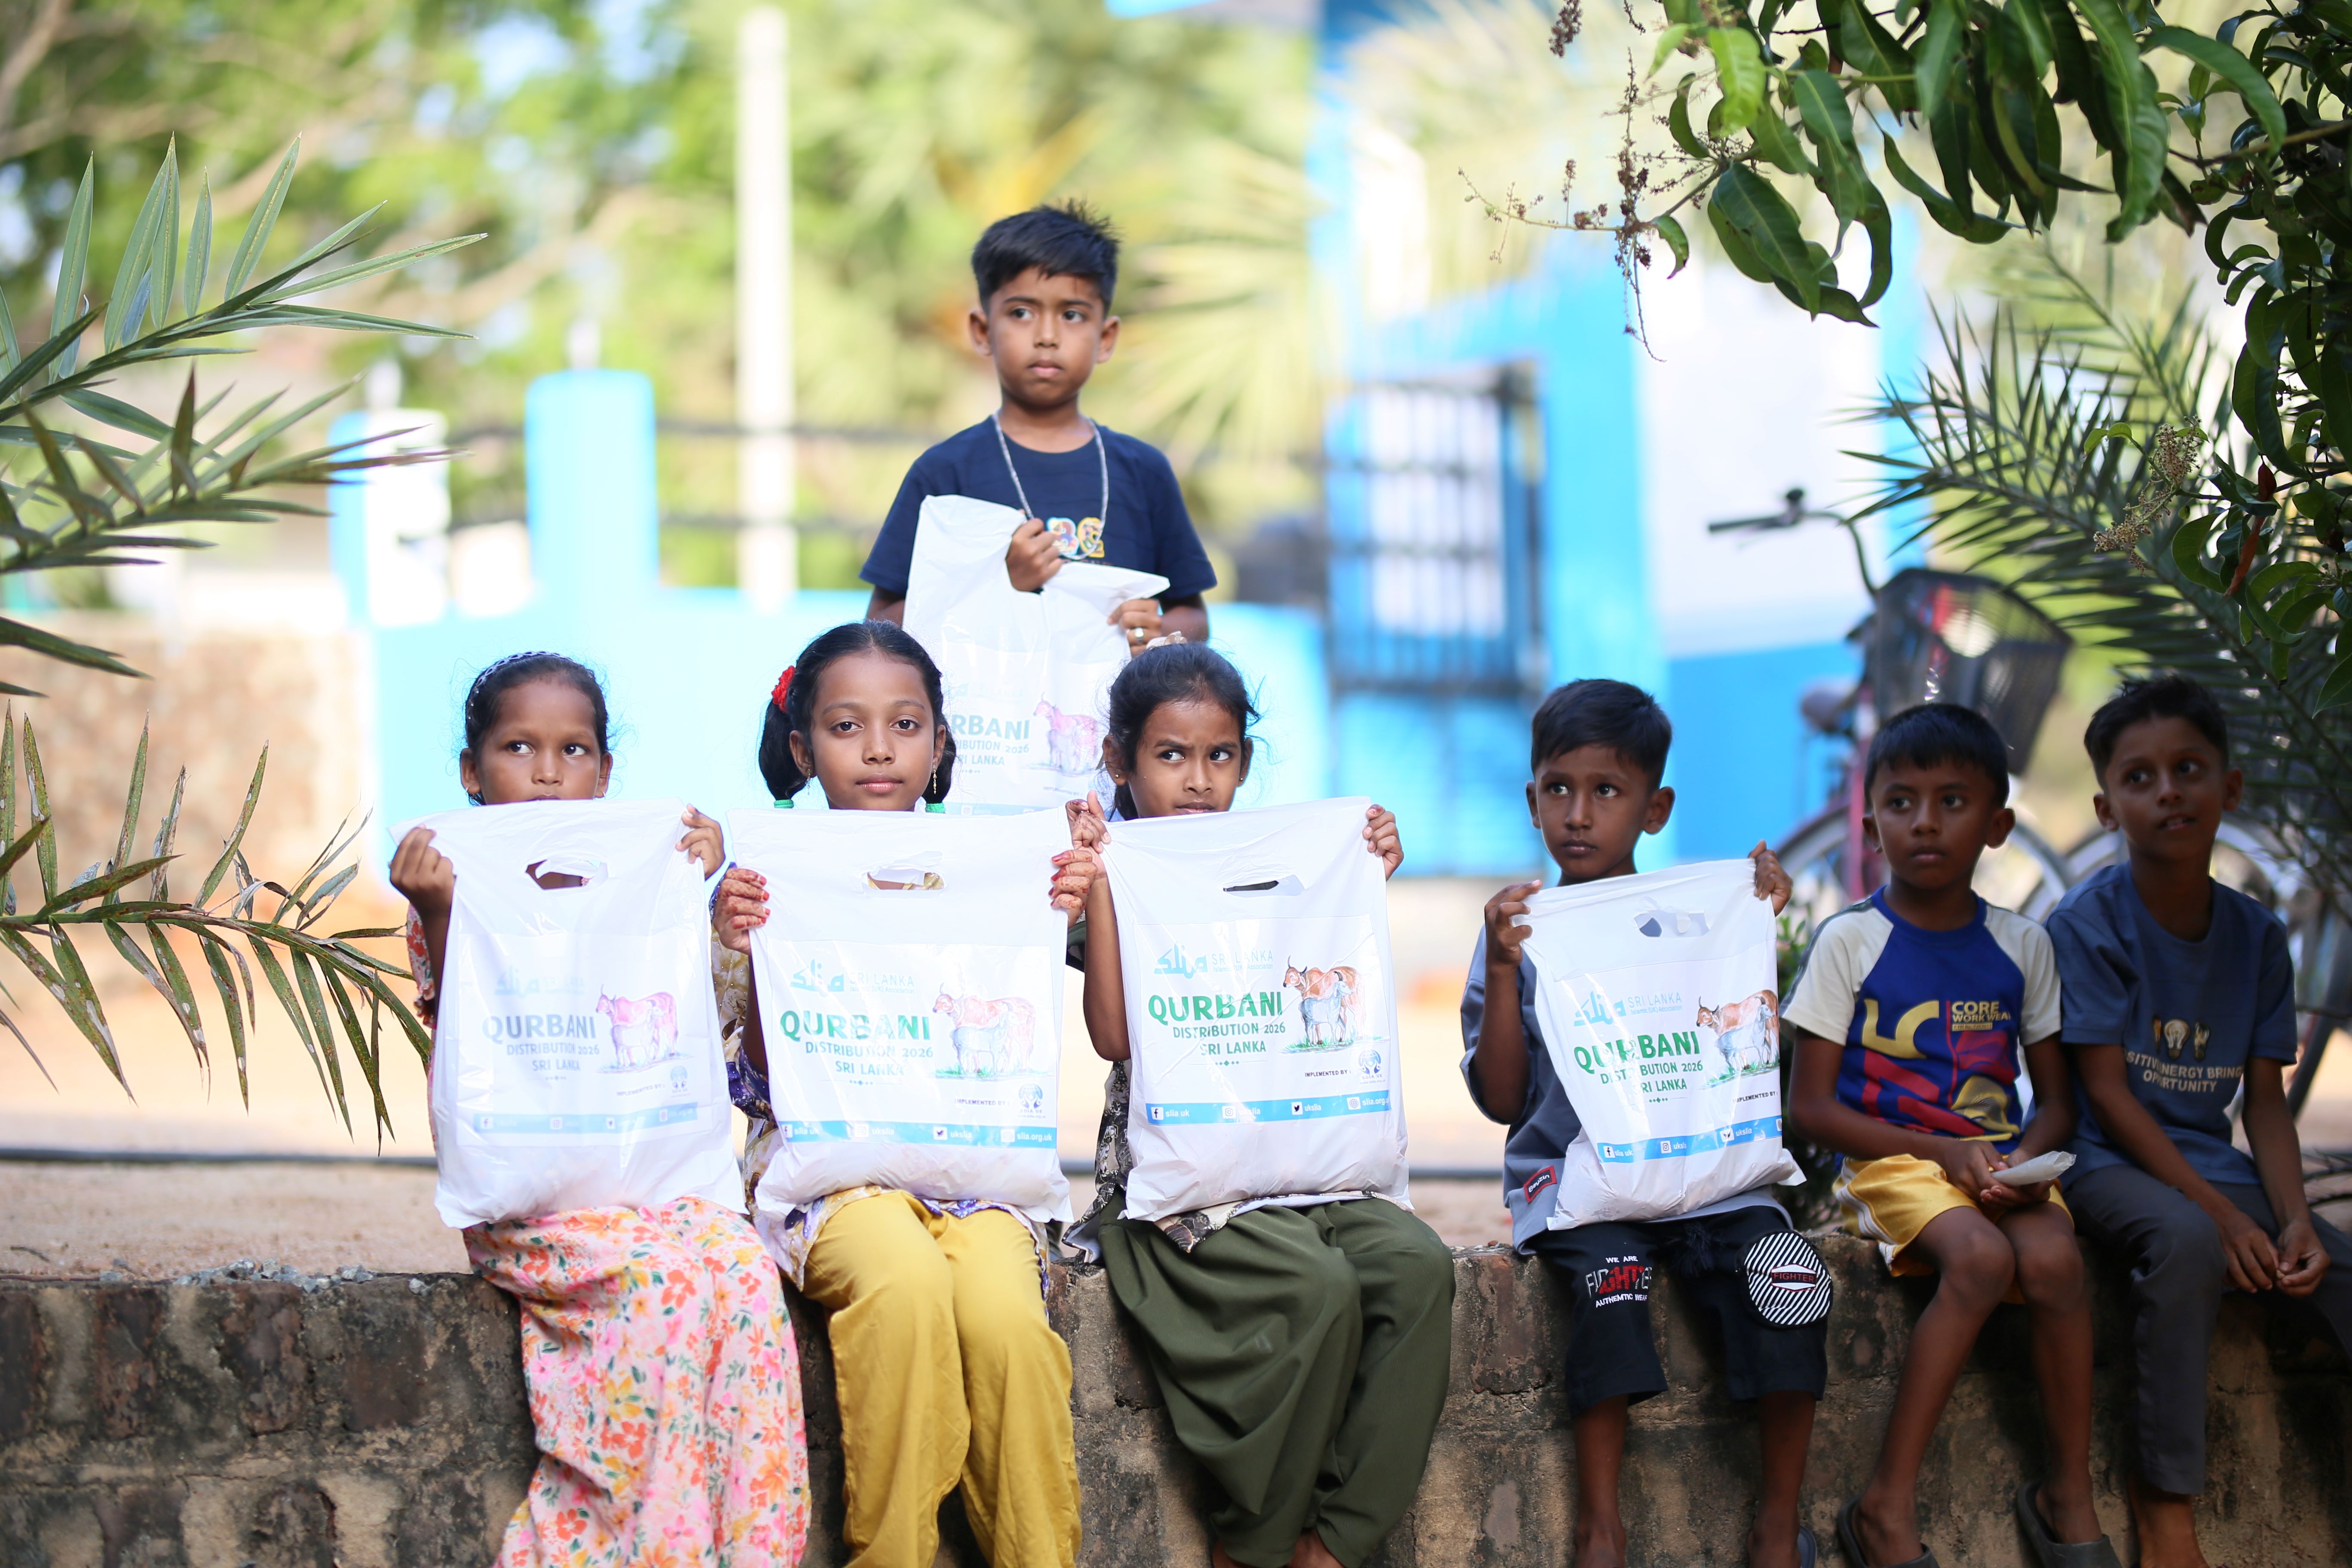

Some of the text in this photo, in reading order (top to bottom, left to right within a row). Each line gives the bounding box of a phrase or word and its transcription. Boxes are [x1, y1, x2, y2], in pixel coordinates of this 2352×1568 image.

[951, 714, 1030, 740] RBANI
[958, 740, 1029, 754] IBUTION 2026
[971, 755, 1005, 766] LANKA
[1235, 949, 1273, 964] LANKA
[874, 973, 914, 987] LANKA
[885, 986, 915, 994] Association
[1628, 992, 1681, 1008] SRI LANKA
[1148, 991, 1283, 1026] QURBANI
[1952, 1001, 2000, 1015] CORE
[1952, 1014, 1985, 1023] WORK
[482, 1014, 597, 1045] QURBANI
[779, 1010, 931, 1042] QURBANI
[1173, 1021, 1286, 1039] DISTRIBUTION 2026
[577, 1044, 600, 1055] 2026
[902, 1046, 934, 1058] 2026
[1200, 1040, 1266, 1056] SRI LANKA
[531, 1059, 551, 1072] SRI
[835, 1060, 904, 1075] SRI LANKA
[1682, 1060, 1703, 1072] 2026
[1642, 1078, 1687, 1093] RI LANKA
[1165, 1109, 1179, 1117] slia
[1304, 1103, 1322, 1112] ukslia
[794, 1127, 820, 1135] slia uk
[872, 1127, 894, 1136] ukslia
[950, 1130, 972, 1139] ukslia
[1017, 1131, 1053, 1142] slia.org.uk
[1736, 1127, 1753, 1137] ukslia
[1774, 1272, 1814, 1283] FIGHTER
